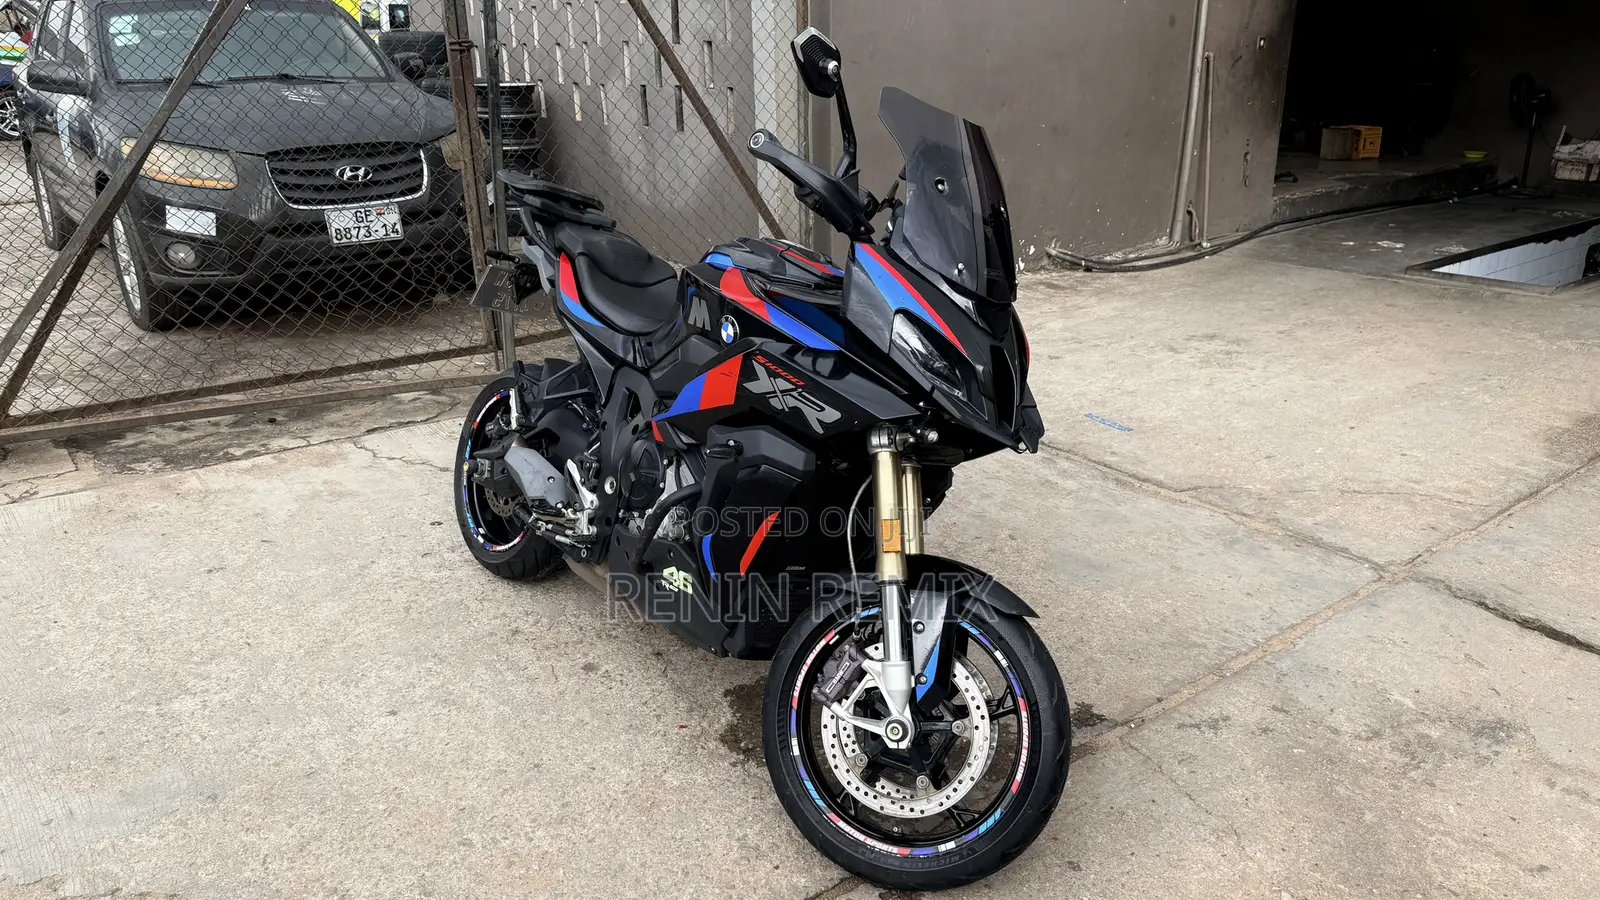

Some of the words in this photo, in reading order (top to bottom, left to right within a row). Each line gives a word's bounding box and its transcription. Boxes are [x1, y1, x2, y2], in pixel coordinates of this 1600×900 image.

[334, 222, 400, 241] 8873-14
[354, 209, 374, 224] GE
[687, 296, 712, 331] M
[753, 355, 806, 386] S1000
[742, 359, 842, 435] XR
[662, 566, 693, 595] 46
